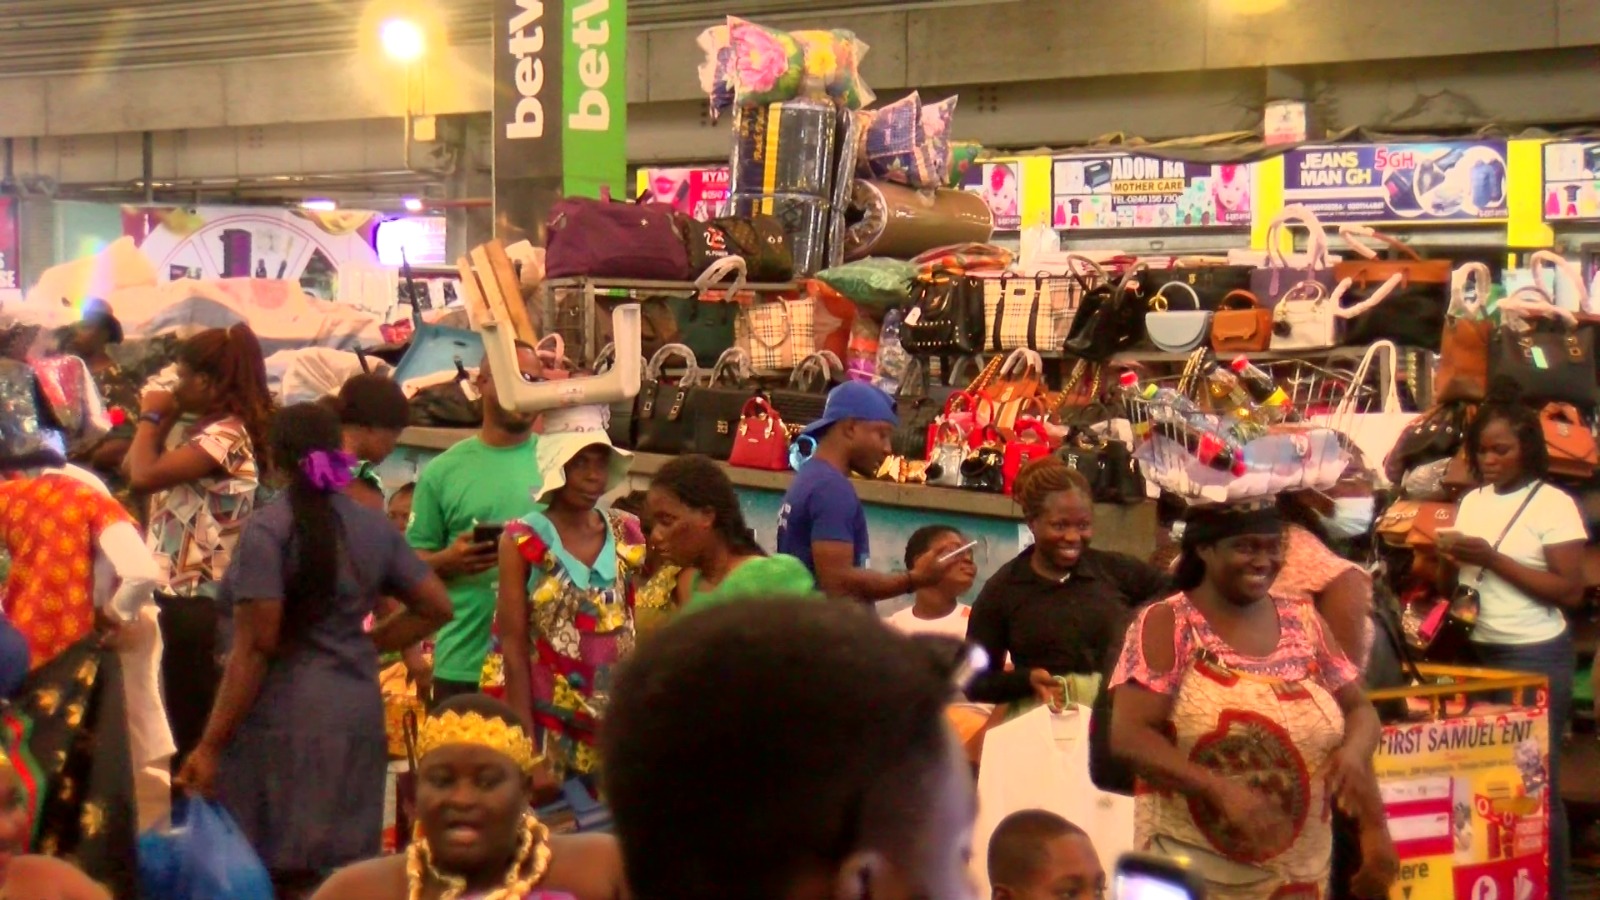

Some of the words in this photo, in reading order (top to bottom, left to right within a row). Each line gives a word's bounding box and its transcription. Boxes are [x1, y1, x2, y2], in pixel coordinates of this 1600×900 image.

[1111, 157, 1160, 180] ADOM
[1300, 151, 1359, 169] JEANS
[1375, 147, 1414, 169] 5GH
[1114, 182, 1155, 192] MOTHER
[1157, 181, 1184, 191] CARE
[1300, 170, 1342, 186] MAN
[1345, 168, 1372, 185] GH
[1378, 729, 1423, 755] FIRST
[1428, 722, 1496, 752] SAMUEL
[1502, 720, 1534, 744] ENT
